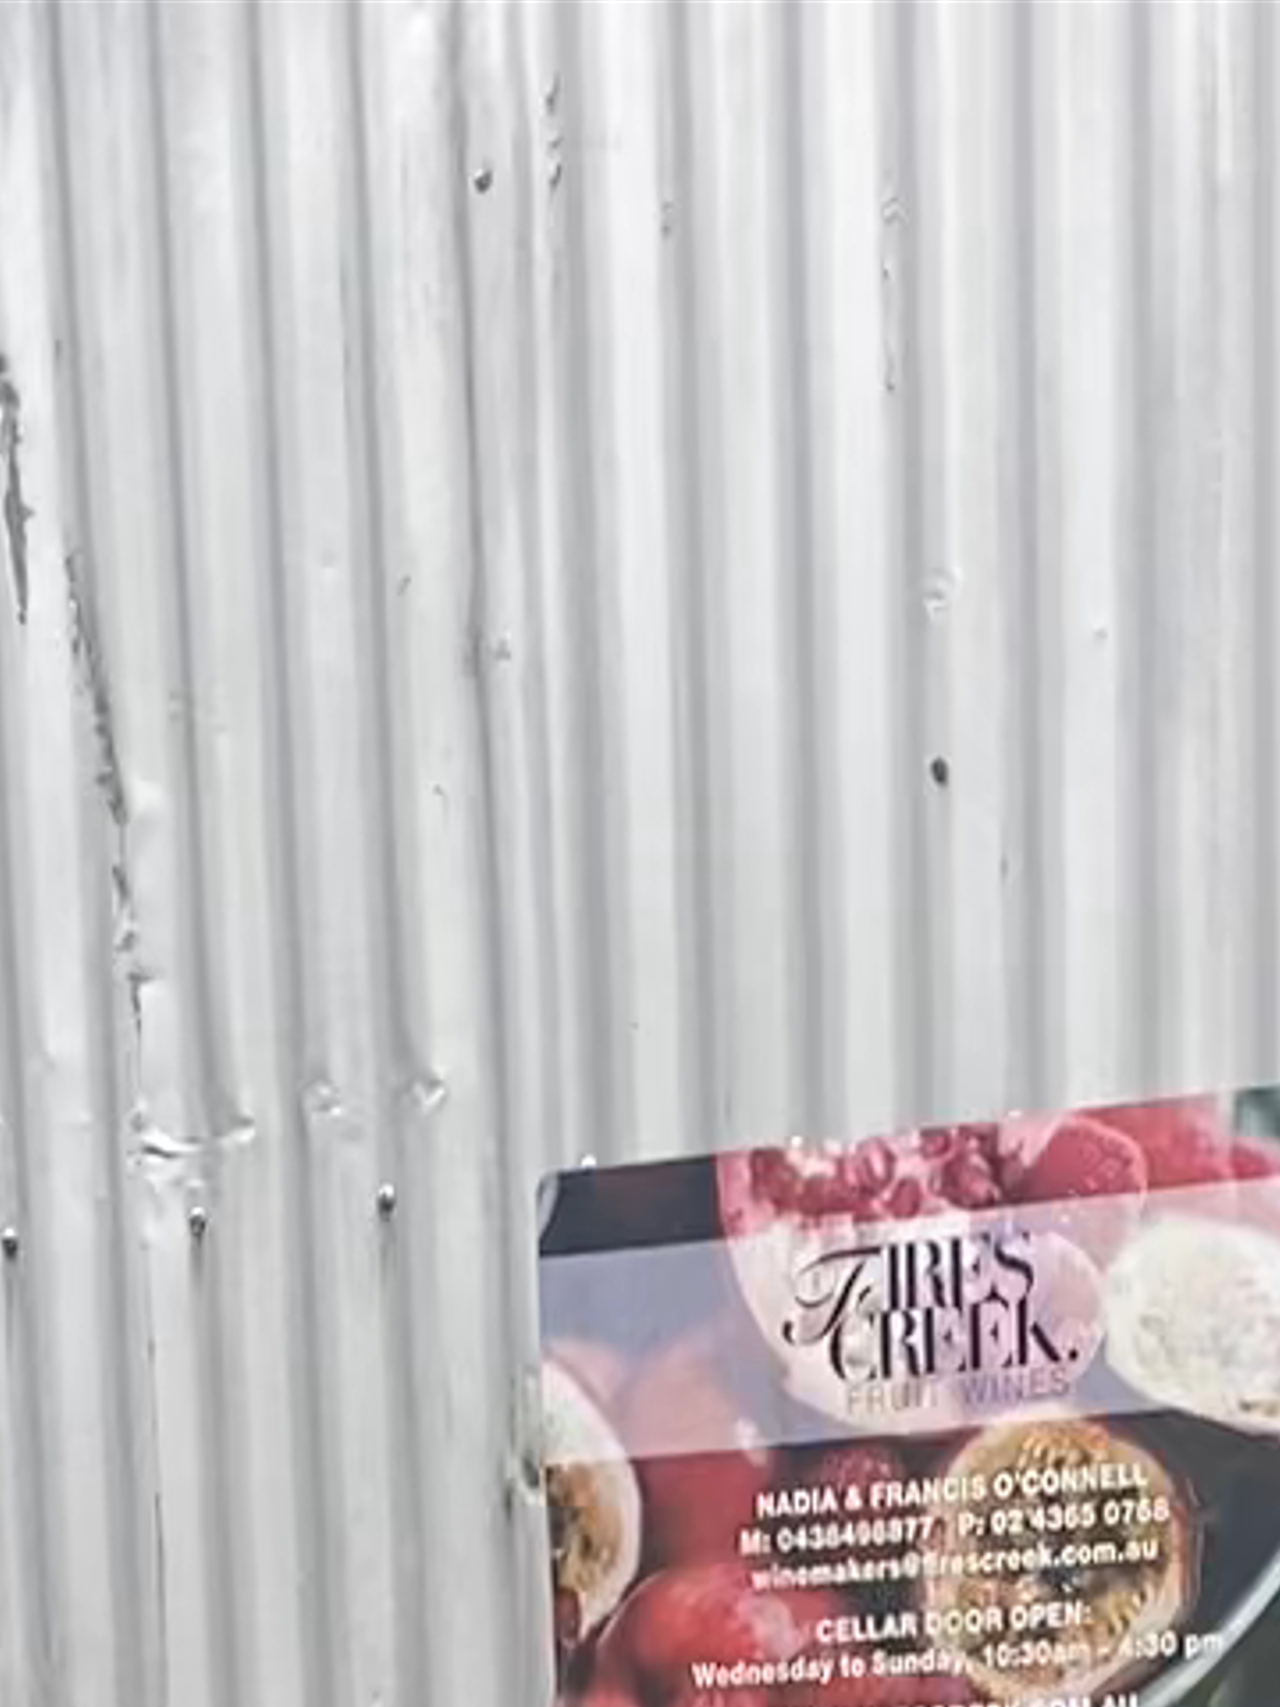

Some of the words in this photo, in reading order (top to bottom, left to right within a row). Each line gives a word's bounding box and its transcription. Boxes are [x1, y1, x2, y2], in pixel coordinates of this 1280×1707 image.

[783, 1232, 1035, 1346] FIRES
[847, 1384, 939, 1415] FRUIT
[963, 1366, 1070, 1406] WINES
[757, 1486, 838, 1519] NADIA
[843, 1484, 863, 1511] &
[869, 1474, 986, 1509] FRANCIS
[993, 1461, 1149, 1499] O'CONNELL
[739, 1527, 770, 1556] M:
[958, 1510, 985, 1536] P:
[990, 1509, 1024, 1535] 02
[1029, 1502, 1096, 1532] 4365
[816, 1611, 918, 1644] CELLAR
[924, 1605, 1003, 1636] DOOR
[1010, 1600, 1094, 1629] OPEN:
[691, 1654, 834, 1689] Wednesday
[840, 1654, 867, 1678] to
[1184, 1632, 1223, 1660] pm
